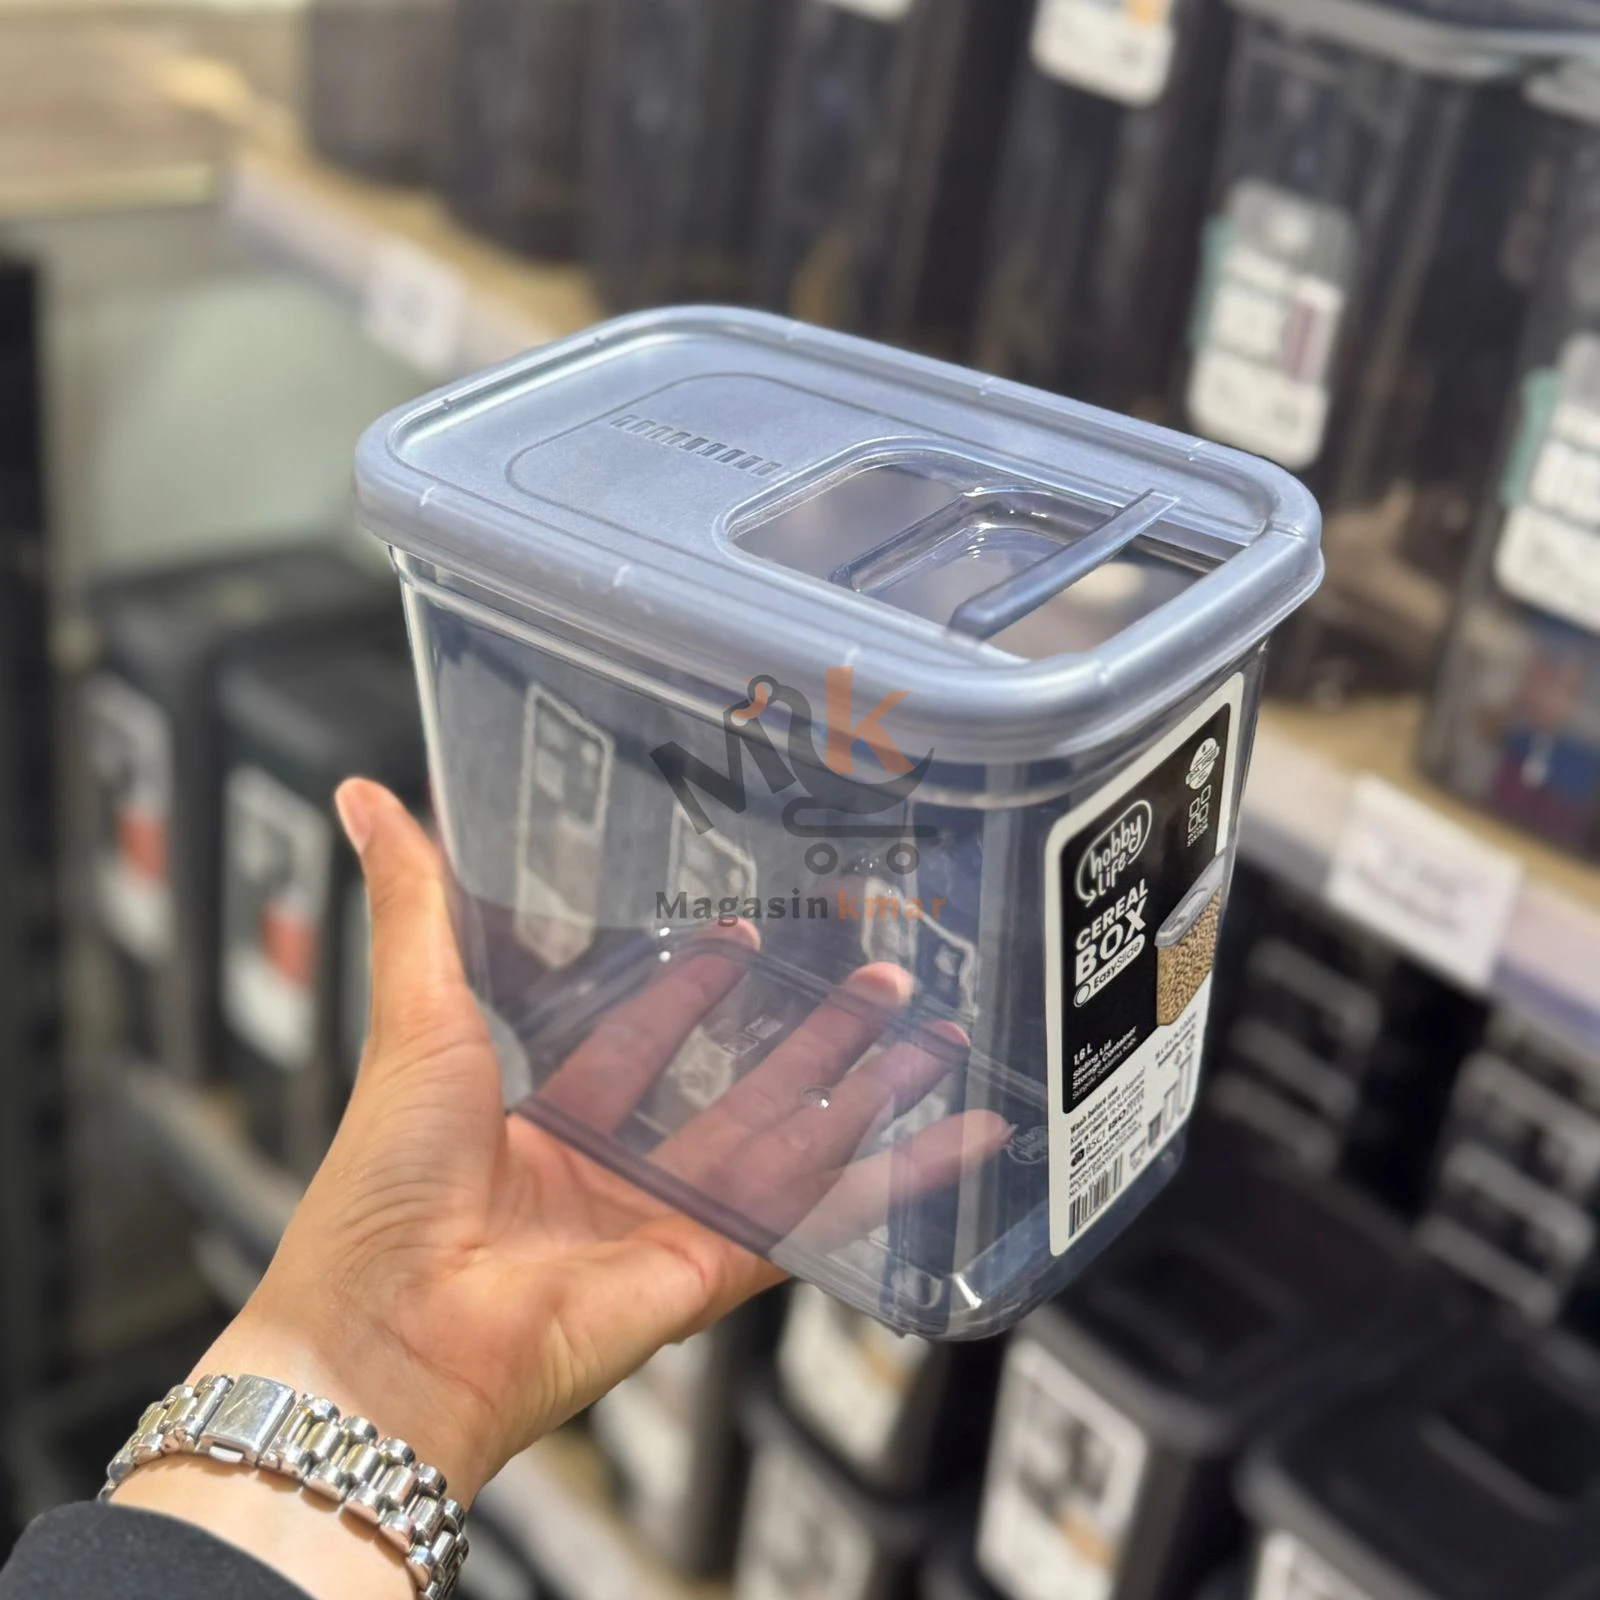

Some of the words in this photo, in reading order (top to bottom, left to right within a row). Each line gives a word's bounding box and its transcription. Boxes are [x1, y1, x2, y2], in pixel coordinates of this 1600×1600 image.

[1090, 814, 1142, 879] hobby
[1075, 896, 1147, 987] BOX
[1076, 878, 1149, 950] CEREAL
[1093, 941, 1141, 989] EasySlide
[1099, 1039, 1112, 1056] Lid
[1102, 1026, 1137, 1062] Container
